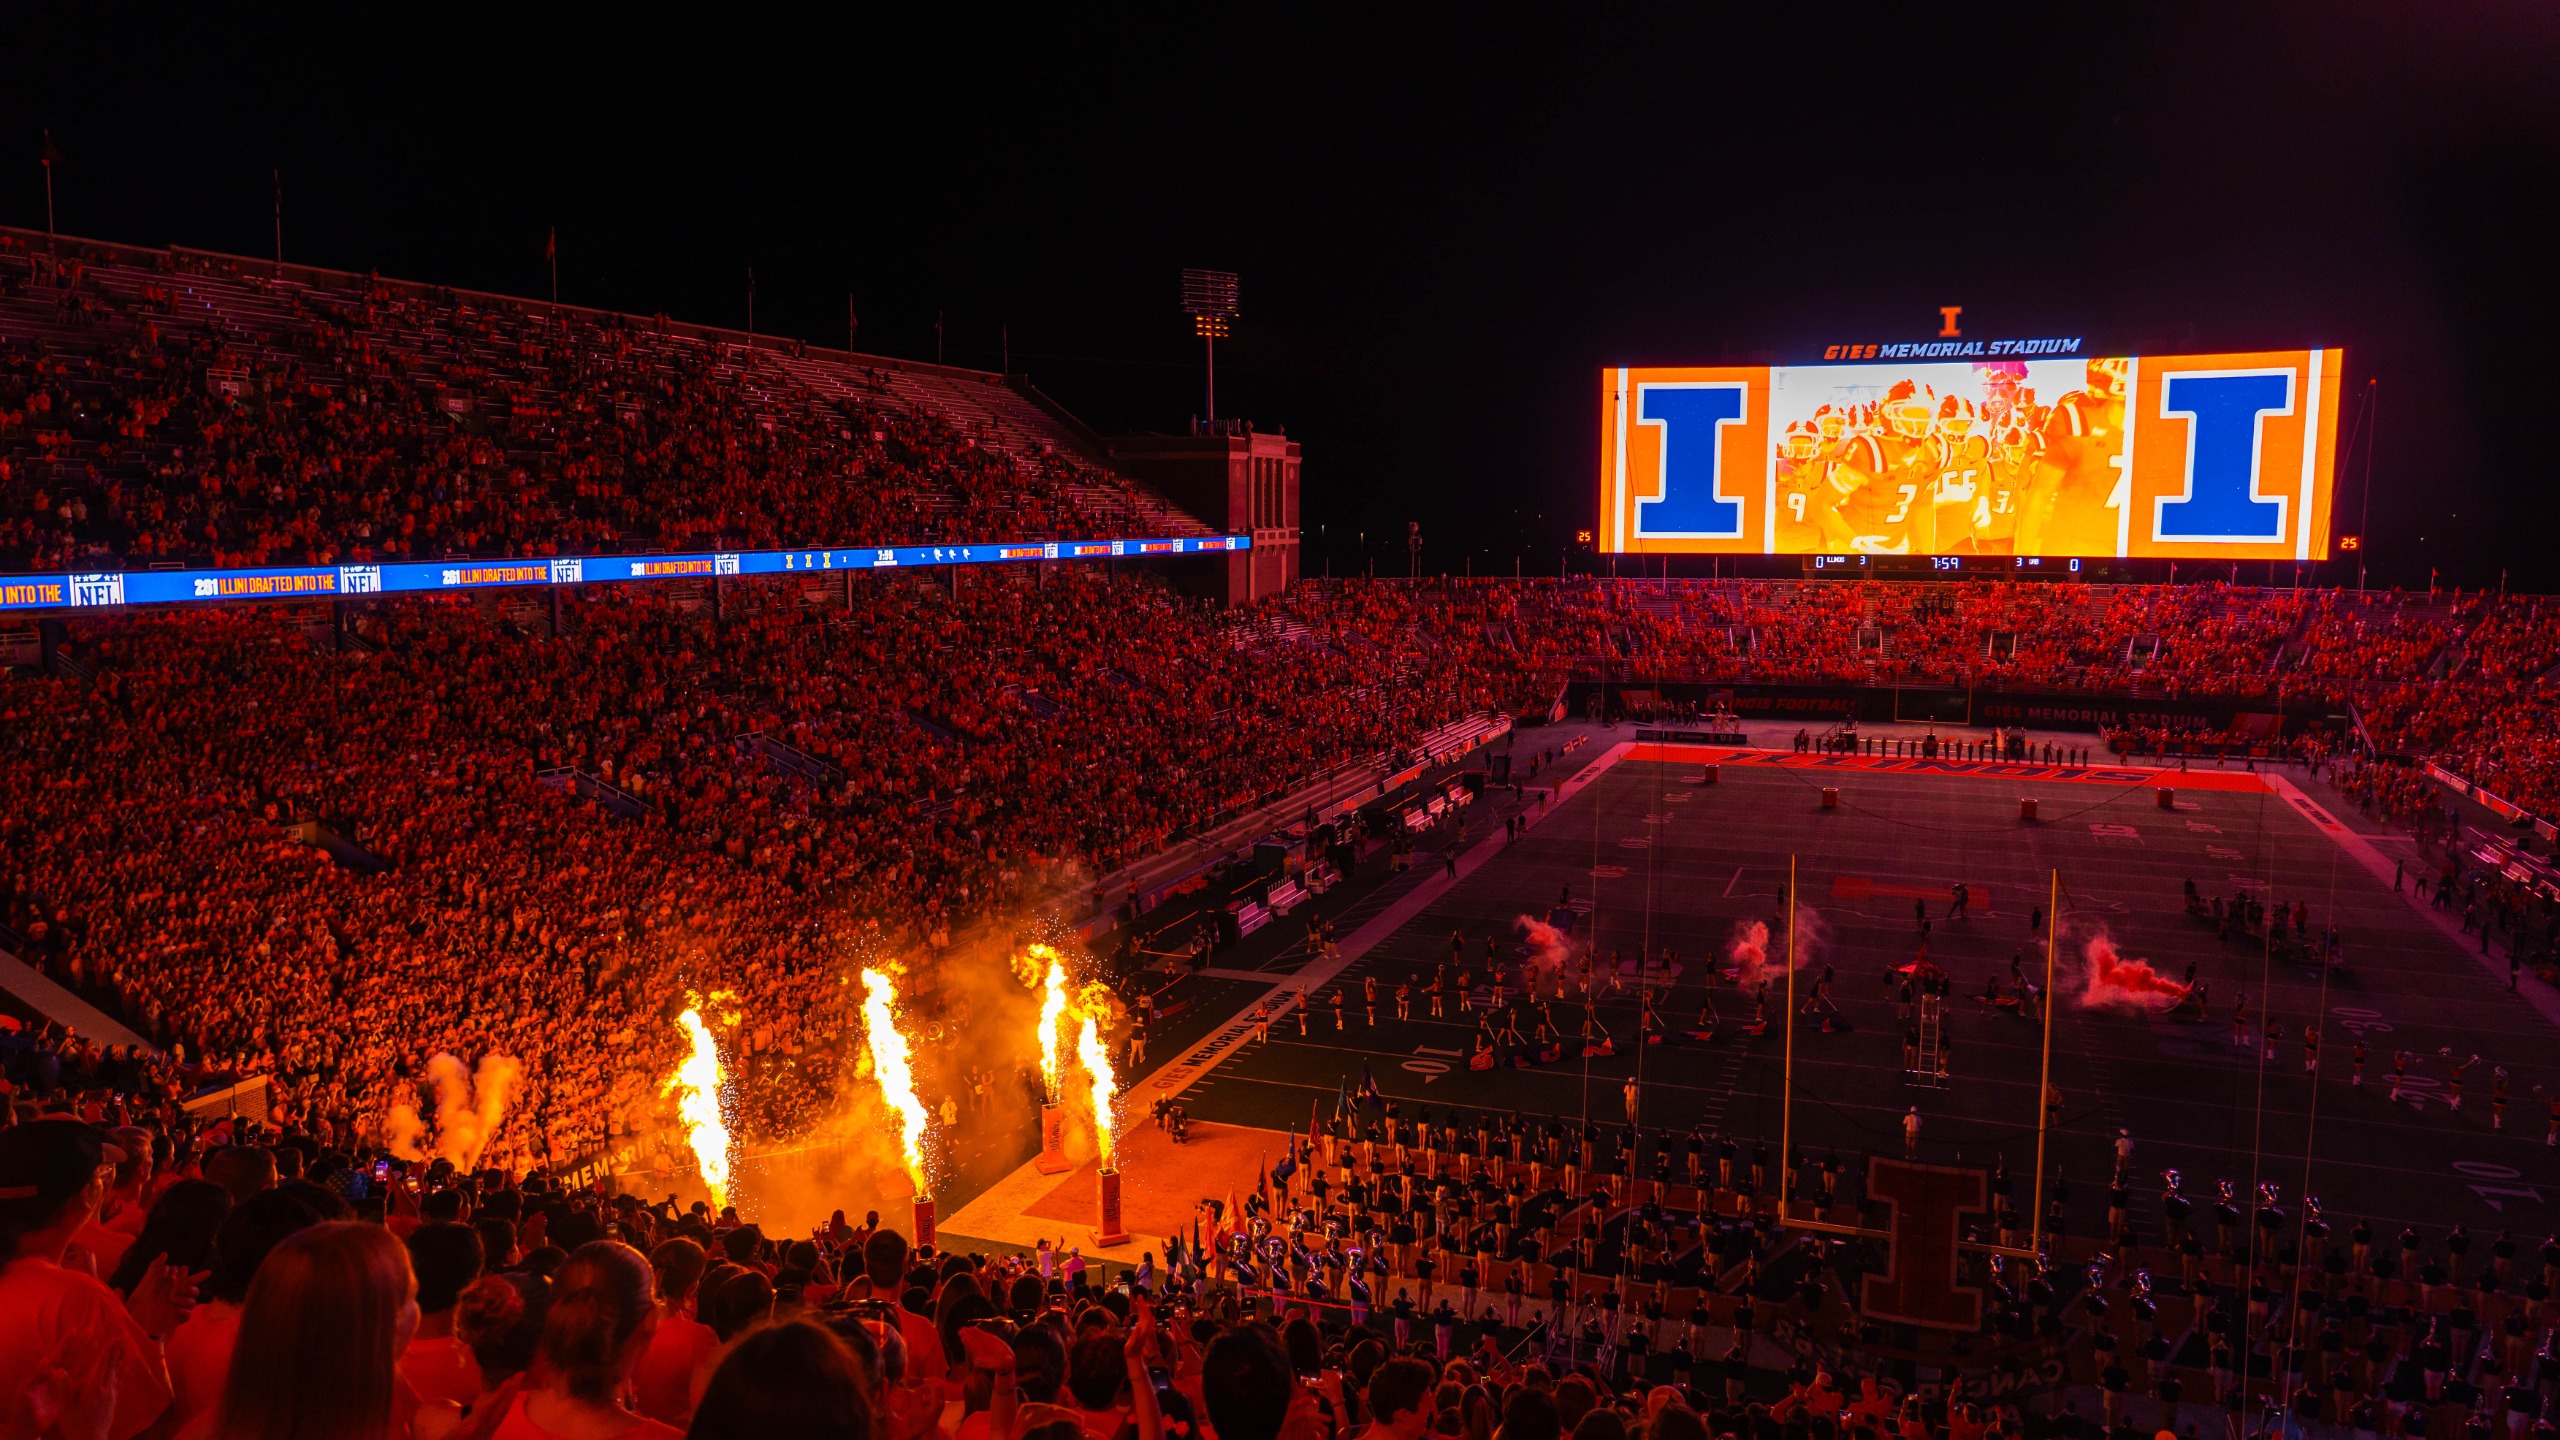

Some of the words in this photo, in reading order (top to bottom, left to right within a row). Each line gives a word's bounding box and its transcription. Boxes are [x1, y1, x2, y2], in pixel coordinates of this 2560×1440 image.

[1938, 306, 1962, 337] I
[1879, 340, 1985, 358] MEMORIAL
[1987, 337, 2082, 356] STADIUM
[1787, 492, 1807, 523] 9
[1885, 484, 1918, 523] 3
[1578, 531, 1591, 542] 25
[2340, 537, 2357, 549] 25
[645, 562, 661, 575] ILLINI
[662, 561, 687, 574] DRAFTED
[688, 561, 701, 573] INTO
[701, 560, 712, 572] THE
[1815, 556, 1824, 569] 0
[1859, 555, 1866, 565] 3
[1931, 557, 1960, 569] 7:59
[2016, 557, 2023, 567] 3
[2070, 558, 2079, 572] 0
[219, 577, 248, 595] ILLINI
[249, 576, 293, 593] DRAFTED
[294, 575, 316, 591] INTO
[317, 574, 335, 589] THE
[345, 575, 378, 593] NFL
[461, 569, 482, 584] ILLINI
[483, 567, 515, 582] DRAFTED
[516, 567, 533, 581] INTO
[533, 566, 548, 580] THE
[5, 585, 36, 604] INTO
[37, 584, 62, 603] THE
[78, 584, 120, 606] NFL
[1775, 697, 1856, 712] FOOTBALL
[1983, 705, 2022, 718] GIES
[2027, 706, 2118, 723] MEMORIAL
[2126, 711, 2208, 729] STADIUM
[1717, 752, 2157, 783] ILLINOIS
[1151, 1067, 1194, 1090] GIES
[1181, 1025, 1254, 1067] MEMORIAL
[1399, 1044, 1464, 1075] 10
[2451, 1161, 2545, 1204] 10
